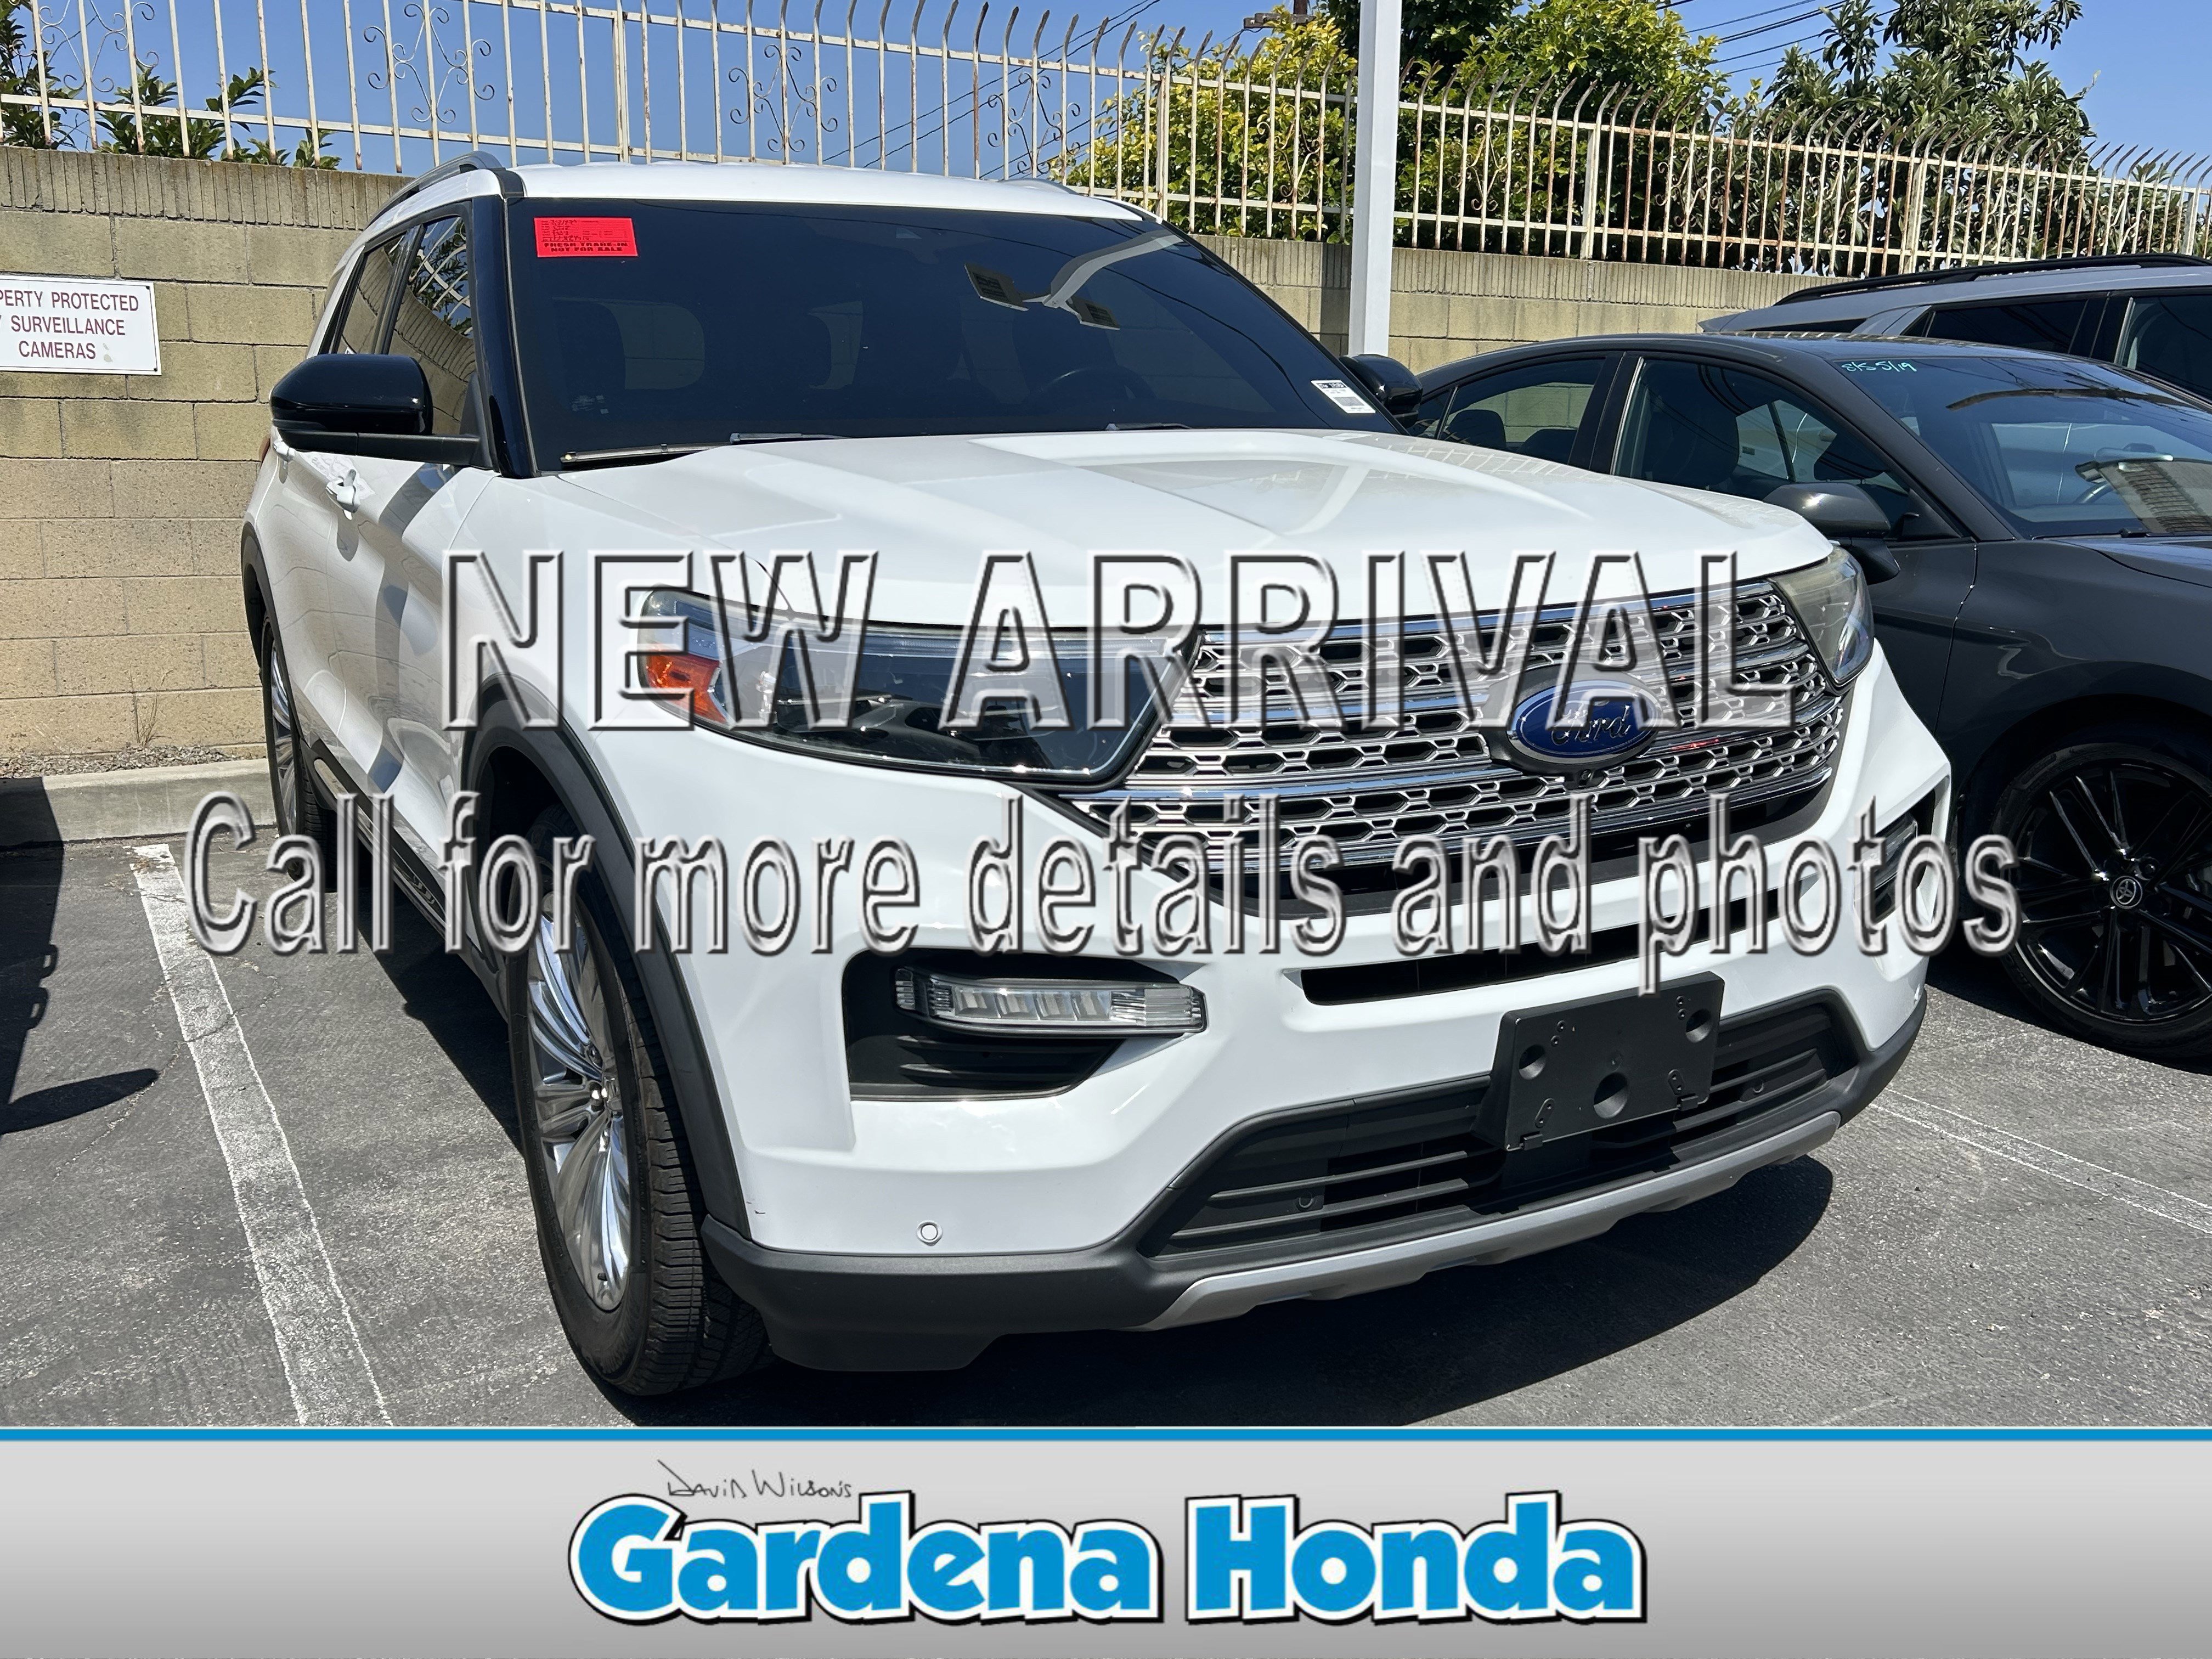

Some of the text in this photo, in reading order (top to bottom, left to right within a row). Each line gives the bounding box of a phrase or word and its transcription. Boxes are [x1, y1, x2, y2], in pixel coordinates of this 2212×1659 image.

[52, 292, 139, 311] PROTECTED
[11, 315, 126, 336] SURVEILLANCE
[19, 340, 96, 359] CAMERAS
[1551, 701, 1632, 745] Ford
